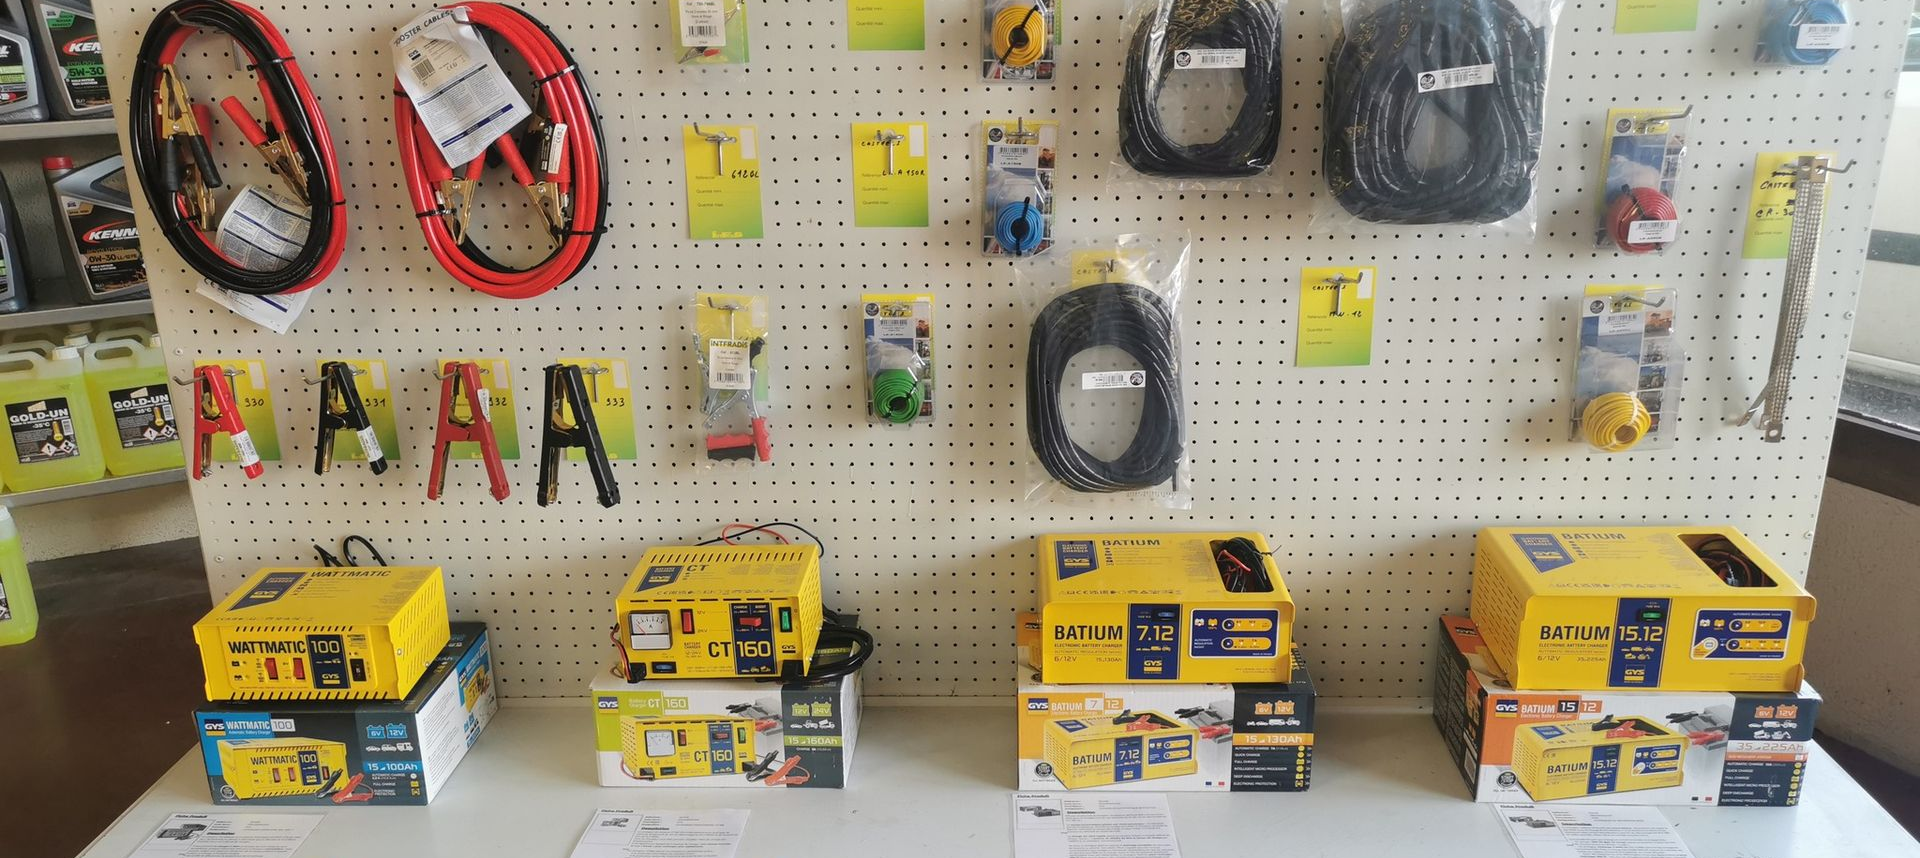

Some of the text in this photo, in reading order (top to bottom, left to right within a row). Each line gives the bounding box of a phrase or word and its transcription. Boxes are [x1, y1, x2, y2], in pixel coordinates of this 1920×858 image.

[69, 66, 104, 77] 5W-30
[89, 227, 139, 241] KENN
[89, 254, 117, 263] 0W-30
[113, 394, 169, 409] GOLD-UN
[10, 408, 69, 424] GOLD-UN
[686, 564, 710, 572] CT
[1054, 625, 1174, 641] BATIUM 7.12
[1540, 625, 1664, 642] BATIUM 15.12
[228, 641, 340, 654] WATTMATIC 100
[708, 641, 771, 658] CT 160
[648, 698, 661, 708] CT
[665, 698, 687, 708] 160
[1028, 700, 1120, 712] GYS BATIUM 7 12
[1496, 702, 1597, 714] GYS BATIUM 15 12
[226, 720, 271, 730] WATTMATIC
[272, 721, 293, 730] 100
[789, 737, 838, 745] 15 160Ah
[1245, 735, 1303, 744] 15 130Ah
[1737, 742, 1804, 751] 35 225Ah
[250, 754, 317, 766] WATTMATIC 100
[694, 750, 733, 763] CT 160
[1072, 749, 1140, 766] BATIUM 7.12
[368, 763, 418, 771] 15 100Ah
[1547, 759, 1618, 774] BATIUM 15.12
